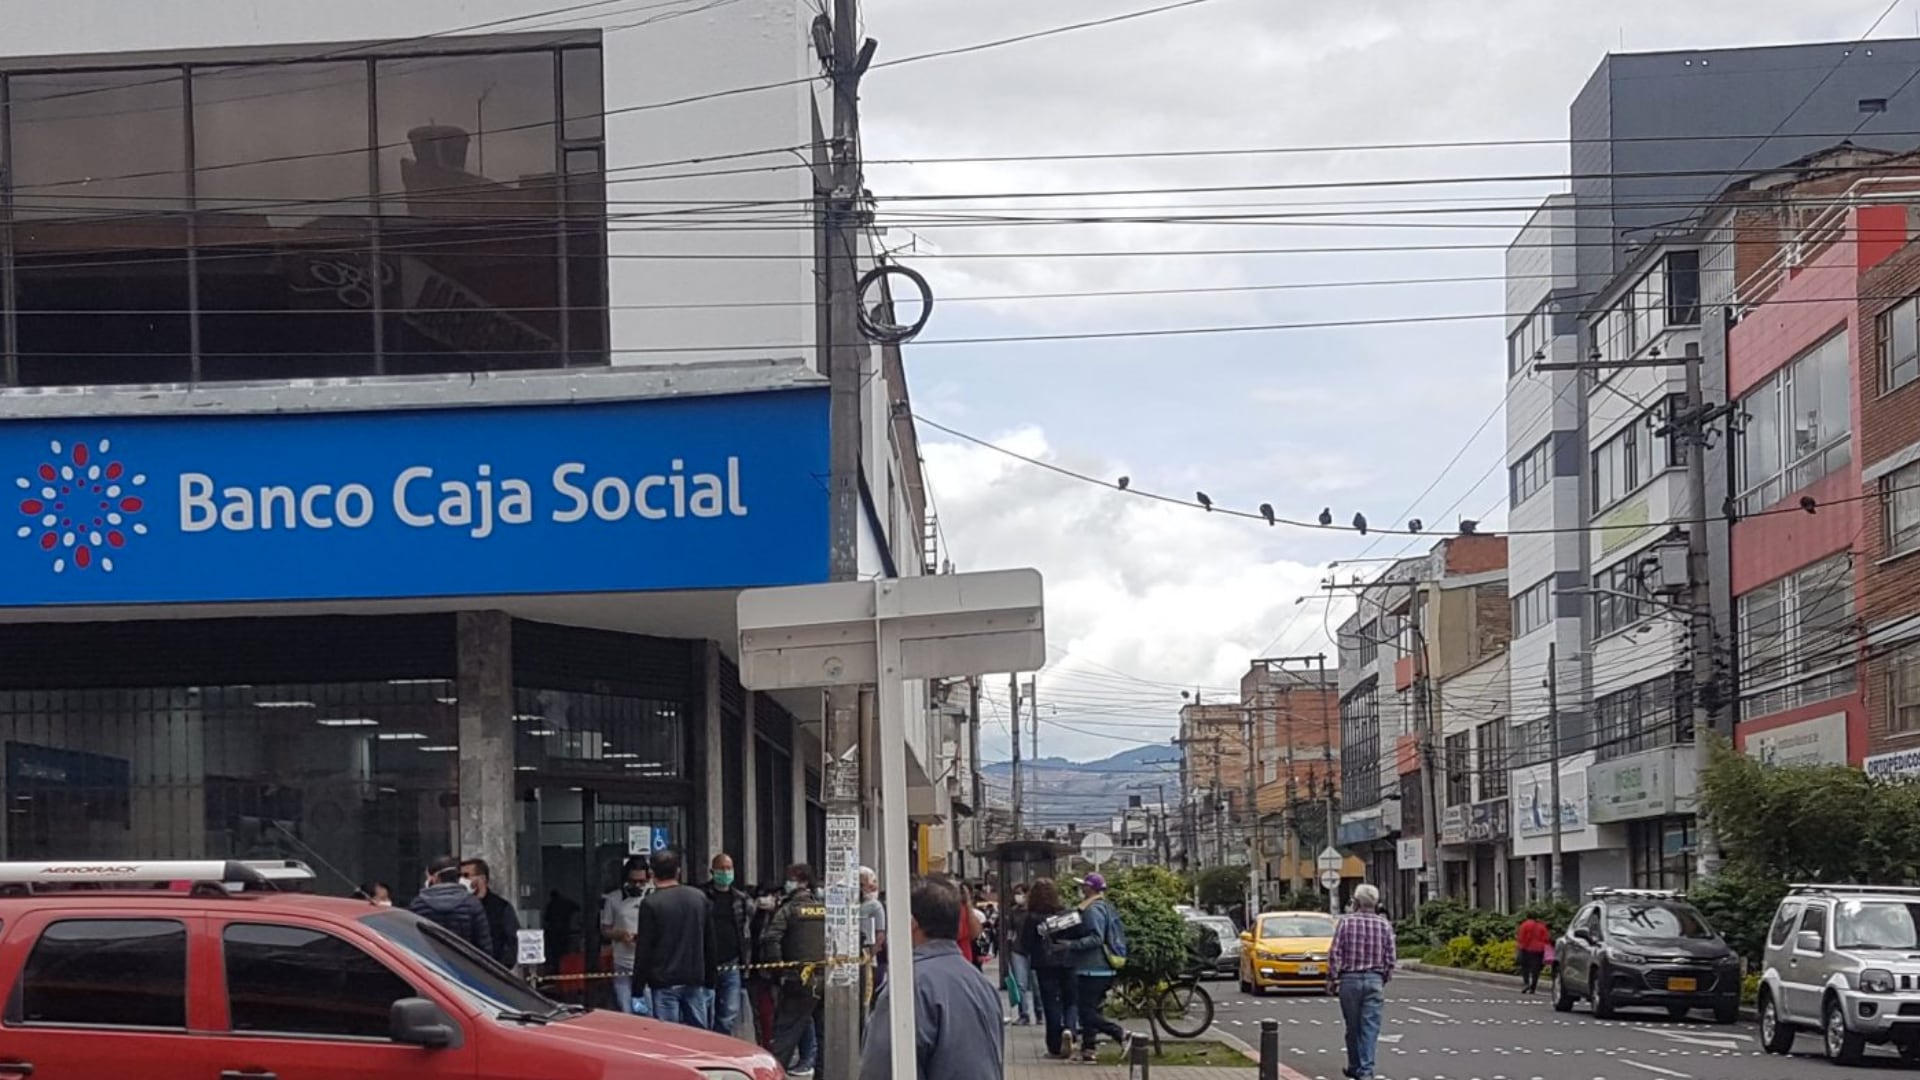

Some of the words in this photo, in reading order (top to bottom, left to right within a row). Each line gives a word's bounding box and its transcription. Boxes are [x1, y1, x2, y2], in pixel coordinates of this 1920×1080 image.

[180, 473, 373, 532] Banco
[393, 464, 532, 538] Caja
[552, 457, 747, 522] Social
